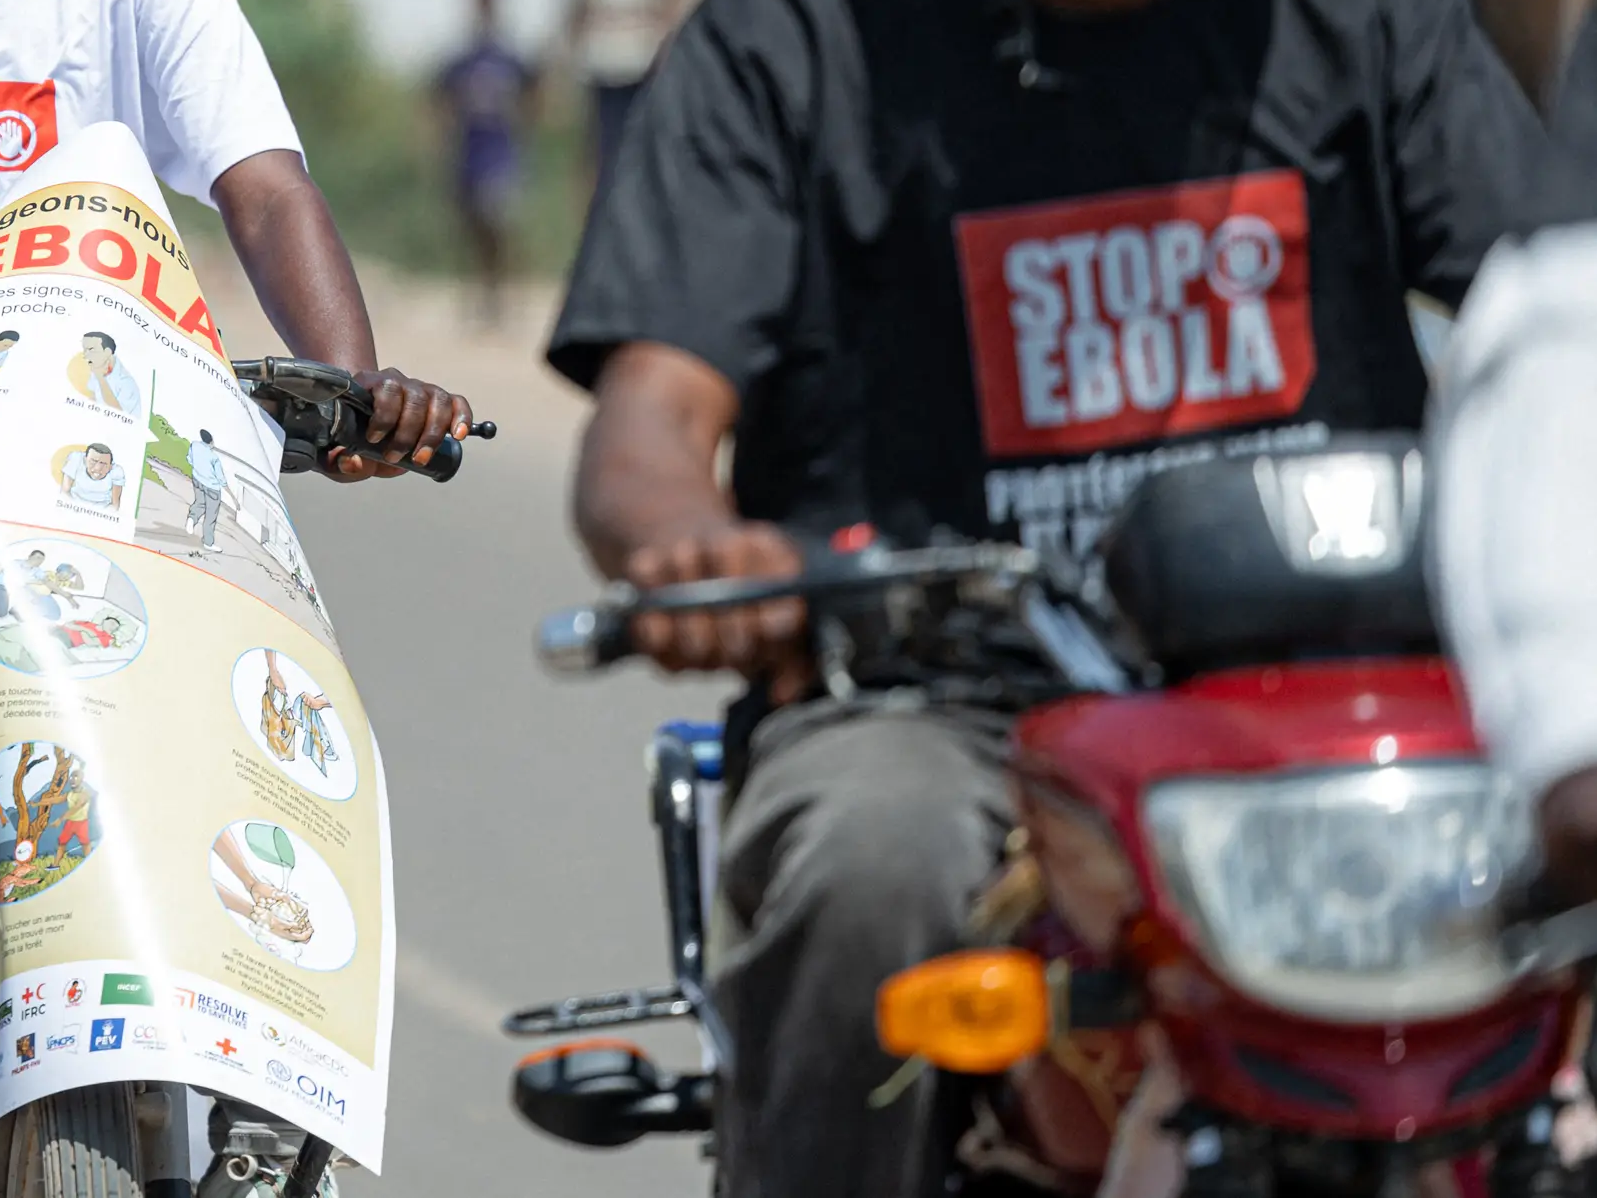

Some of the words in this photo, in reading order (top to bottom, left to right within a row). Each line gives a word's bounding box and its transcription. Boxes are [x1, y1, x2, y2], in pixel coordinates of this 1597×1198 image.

[1004, 221, 1206, 327] STOP
[1, 301, 71, 318] proche.
[22, 283, 88, 302] signes,
[96, 293, 150, 333] rendez
[153, 329, 189, 358] vous
[1015, 298, 1285, 430] EBOLA
[66, 396, 85, 409] Mal
[87, 403, 101, 413] de
[104, 407, 134, 426] gorge
[55, 499, 121, 524] Saignement
[8, 687, 43, 697] toucher
[32, 916, 42, 925] un
[44, 911, 73, 923] animal
[45, 924, 65, 934] mort
[21, 1003, 46, 1021] IFRC
[197, 1005, 208, 1014] TO
[209, 1008, 228, 1023] SAVE
[227, 1015, 248, 1030] LIVES
[198, 993, 248, 1021] RESOLVE
[95, 1034, 117, 1046] PEV
[297, 1075, 345, 1116] OIM
